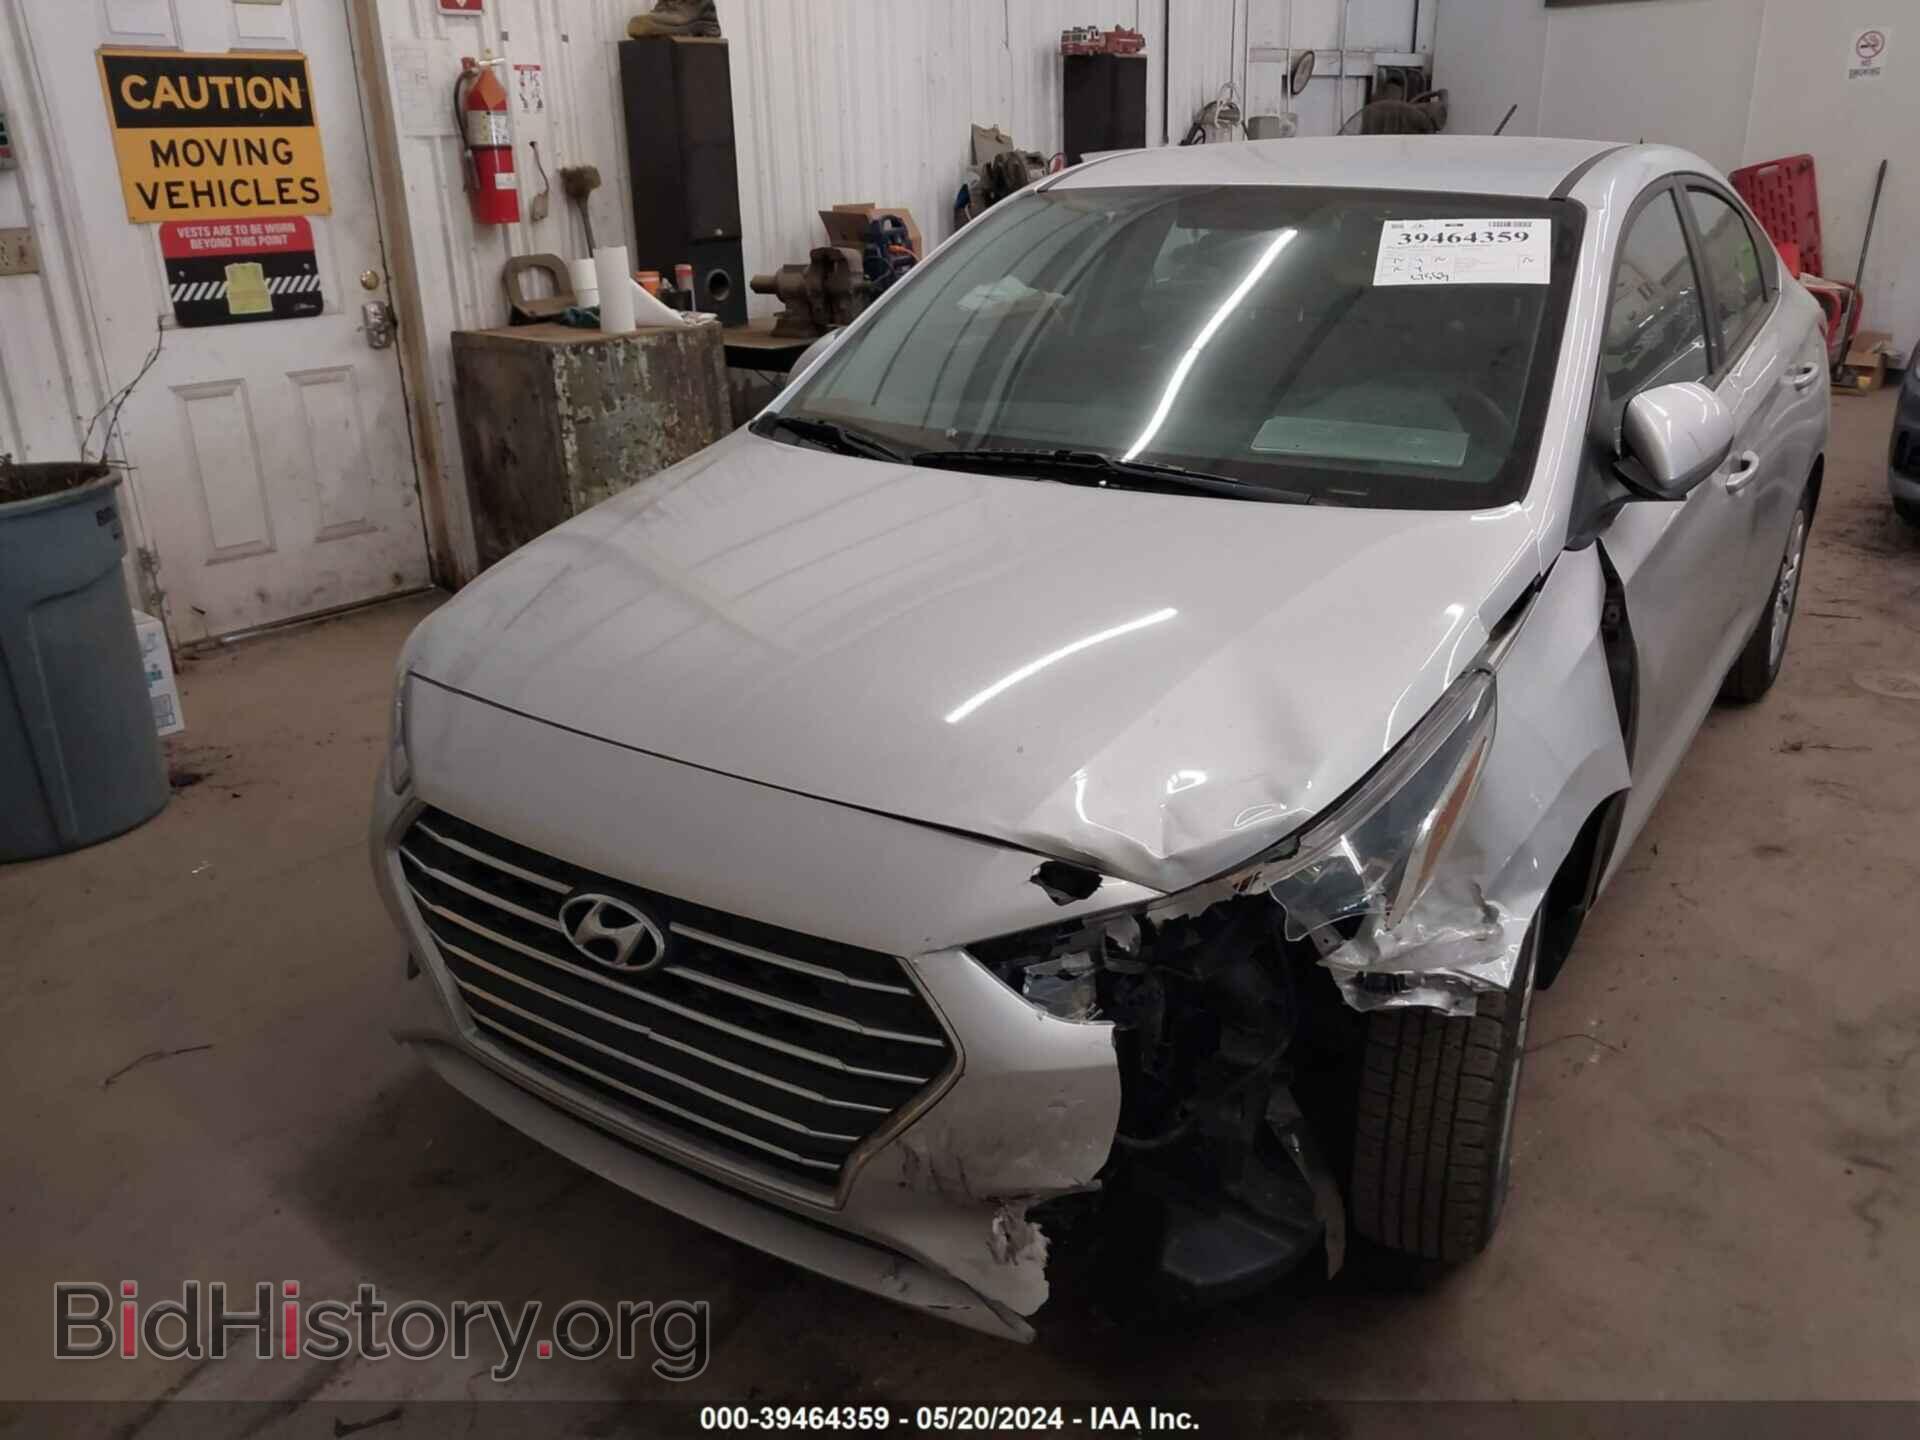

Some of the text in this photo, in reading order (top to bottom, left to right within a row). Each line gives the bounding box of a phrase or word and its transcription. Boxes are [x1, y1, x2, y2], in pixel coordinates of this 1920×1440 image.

[121, 75, 302, 109] CAUTION
[151, 138, 294, 168] MOVING
[136, 177, 320, 210] VEHICLES
[177, 226, 210, 238] VESTS
[212, 225, 234, 237] ARE
[235, 224, 248, 235] TO
[190, 237, 232, 249] BEYOND
[258, 234, 288, 246] POINT
[1397, 231, 1530, 245] 39464359
